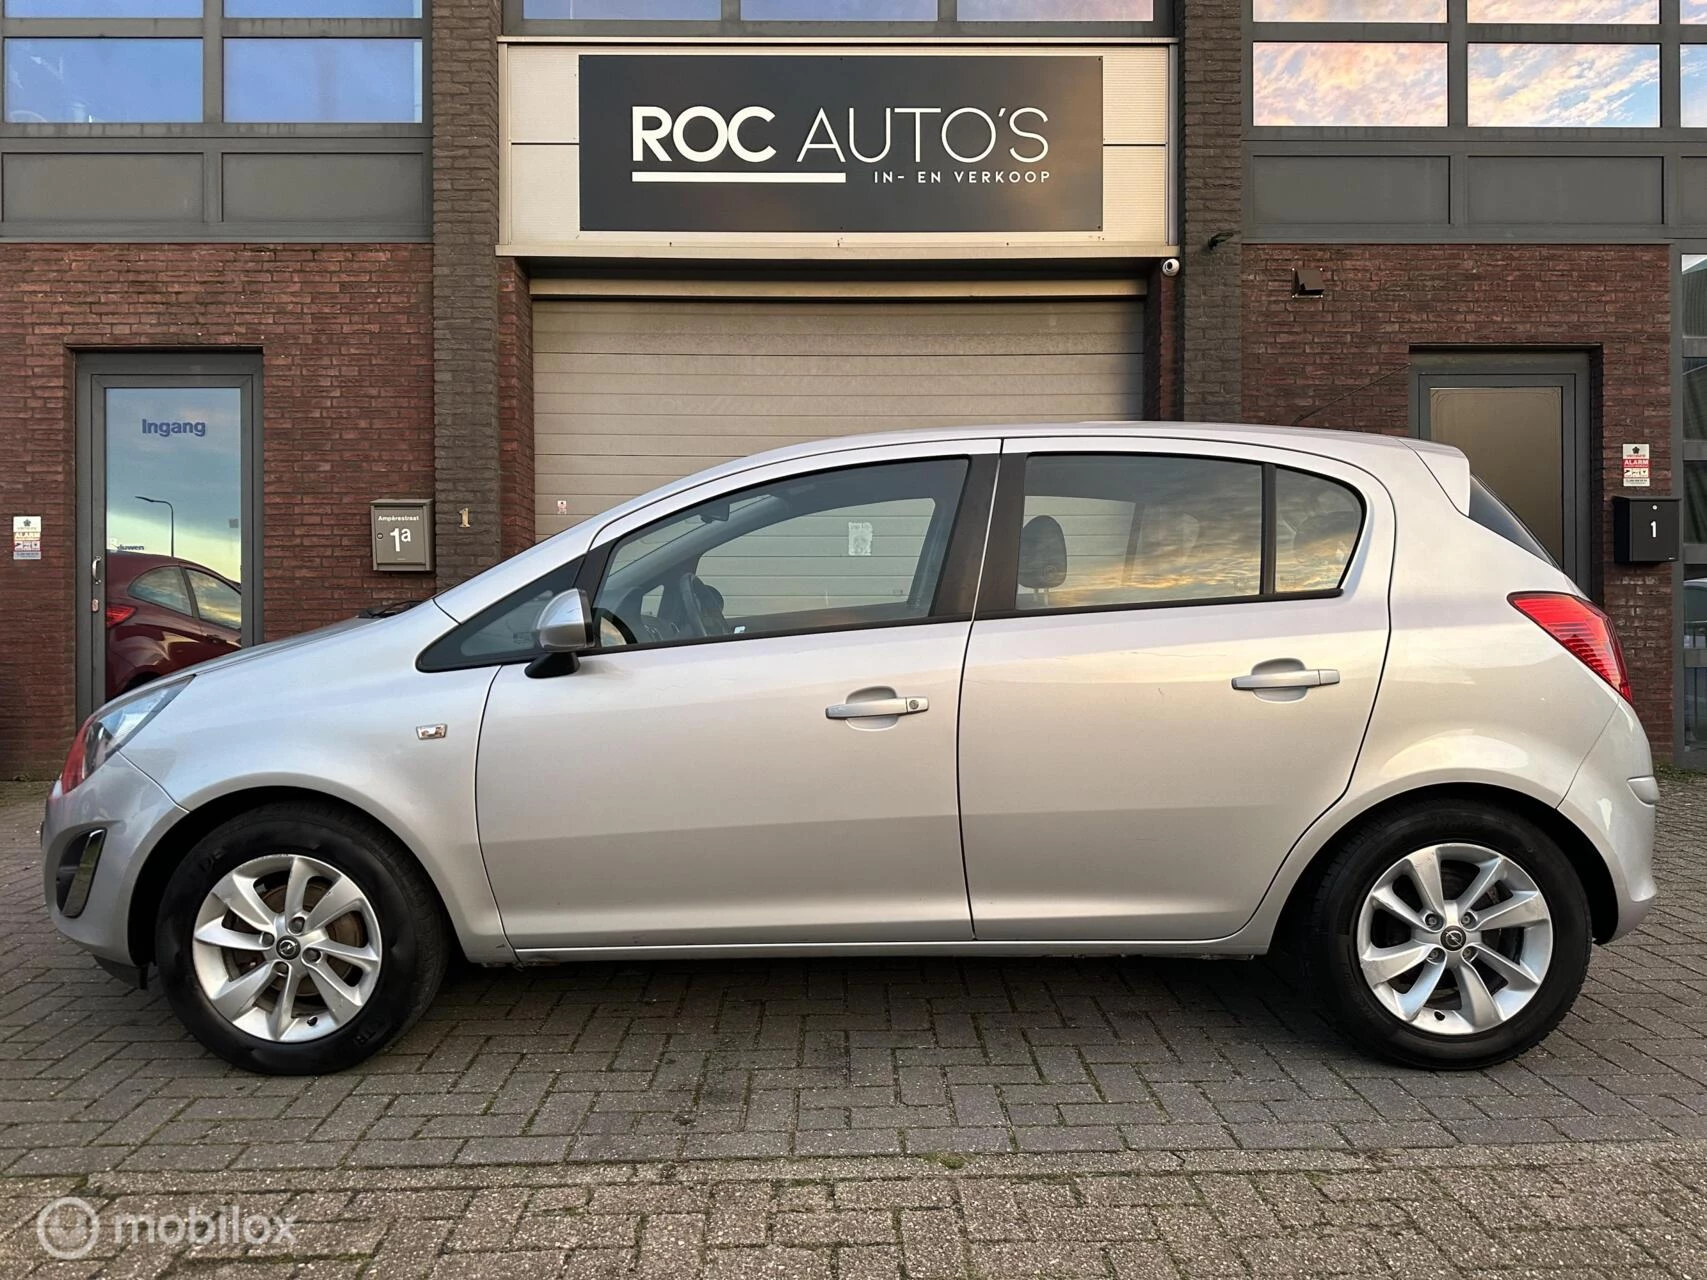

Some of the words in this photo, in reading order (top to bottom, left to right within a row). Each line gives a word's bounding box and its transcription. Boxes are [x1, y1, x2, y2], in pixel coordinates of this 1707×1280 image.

[632, 105, 777, 163] ROC
[797, 106, 1050, 163] AUTO'S
[874, 171, 905, 184] IN-
[917, 171, 941, 184] EN
[953, 170, 1051, 184] VERKOOP
[142, 418, 206, 438] Ingang
[459, 507, 471, 528] 1
[1650, 520, 1657, 538] 1
